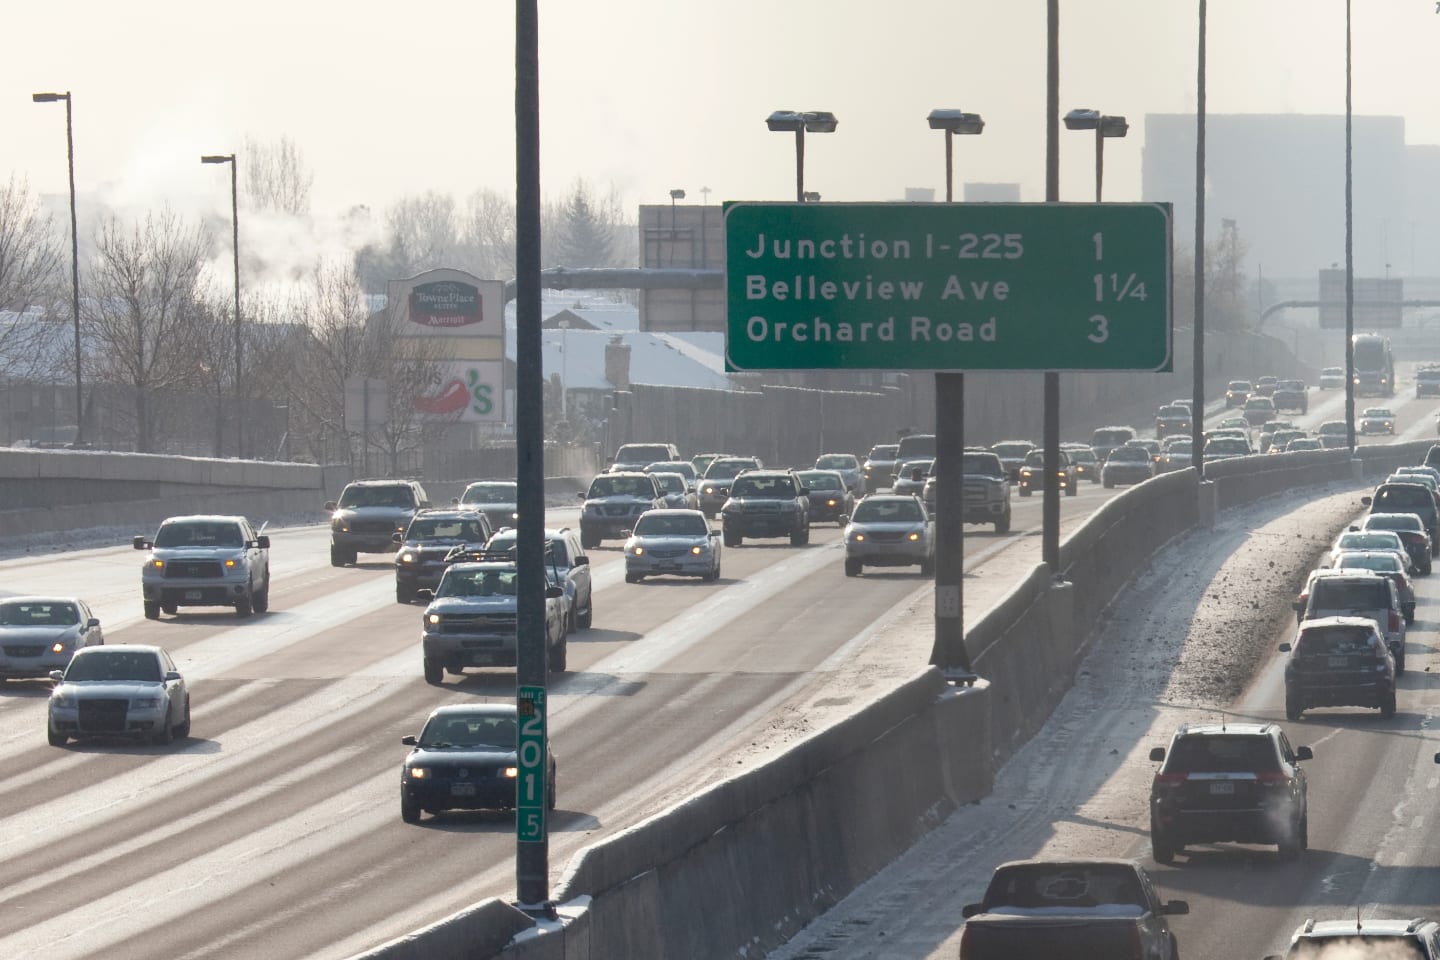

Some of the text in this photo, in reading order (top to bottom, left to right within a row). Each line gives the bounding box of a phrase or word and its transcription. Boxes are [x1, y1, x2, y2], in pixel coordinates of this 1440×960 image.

[746, 232, 1103, 261] Junction I-225 1
[746, 274, 924, 301] Belleview
[940, 274, 1010, 300] Ave
[746, 315, 1109, 343] Orchard Road 3
